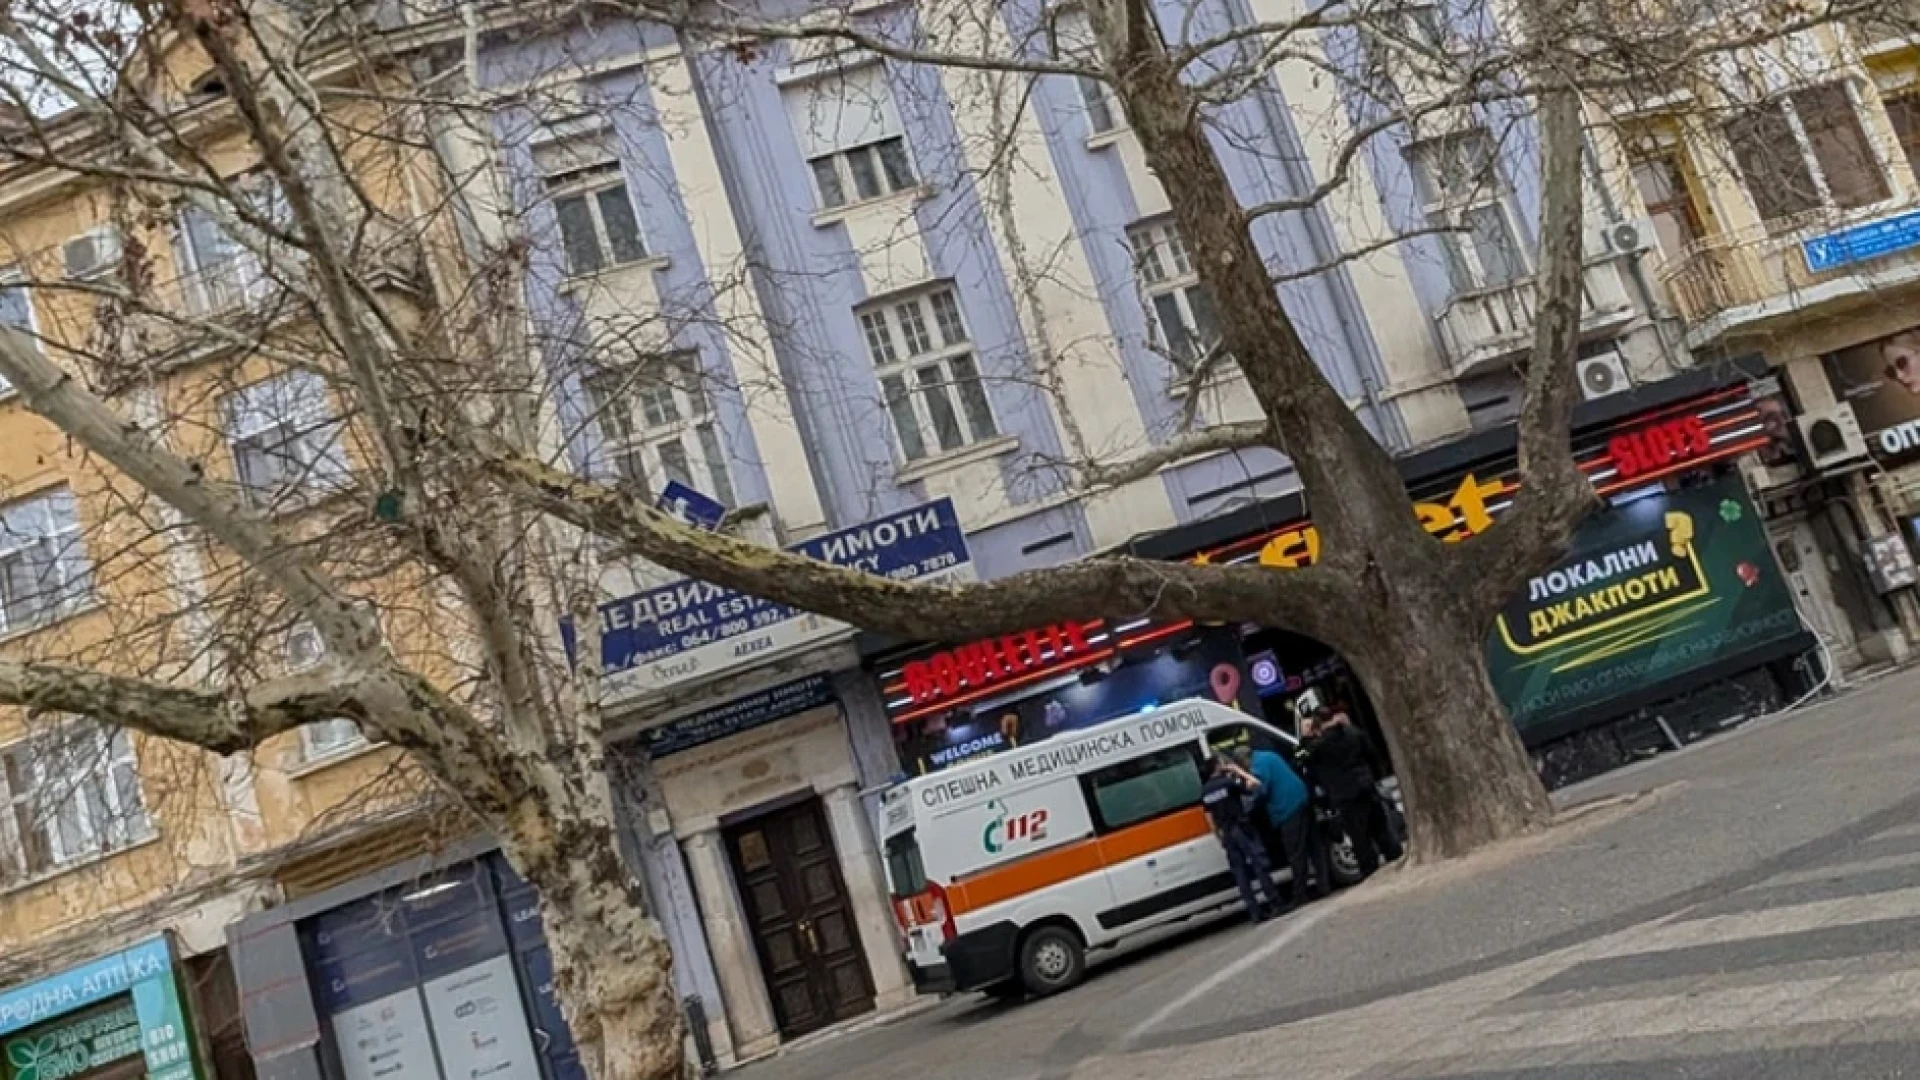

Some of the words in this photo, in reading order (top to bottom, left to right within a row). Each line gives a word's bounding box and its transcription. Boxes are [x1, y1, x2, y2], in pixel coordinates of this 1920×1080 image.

[1608, 414, 1711, 476] SLOTS
[821, 507, 940, 562] ИМОТИ
[1528, 540, 1659, 601] ЛОКАЛНИ
[658, 608, 714, 636] REAL
[1529, 566, 1681, 637] ДЖАКПОТИ
[901, 619, 1088, 704] ROULETTE
[922, 769, 1002, 807] СПЕШНА
[1009, 730, 1136, 780] МЕДИЦИНСКА
[1140, 708, 1208, 744] ПОМОЩ
[930, 731, 1003, 765] WELCOME
[1006, 808, 1048, 841] 112
[0, 983, 77, 1028] РОДНА
